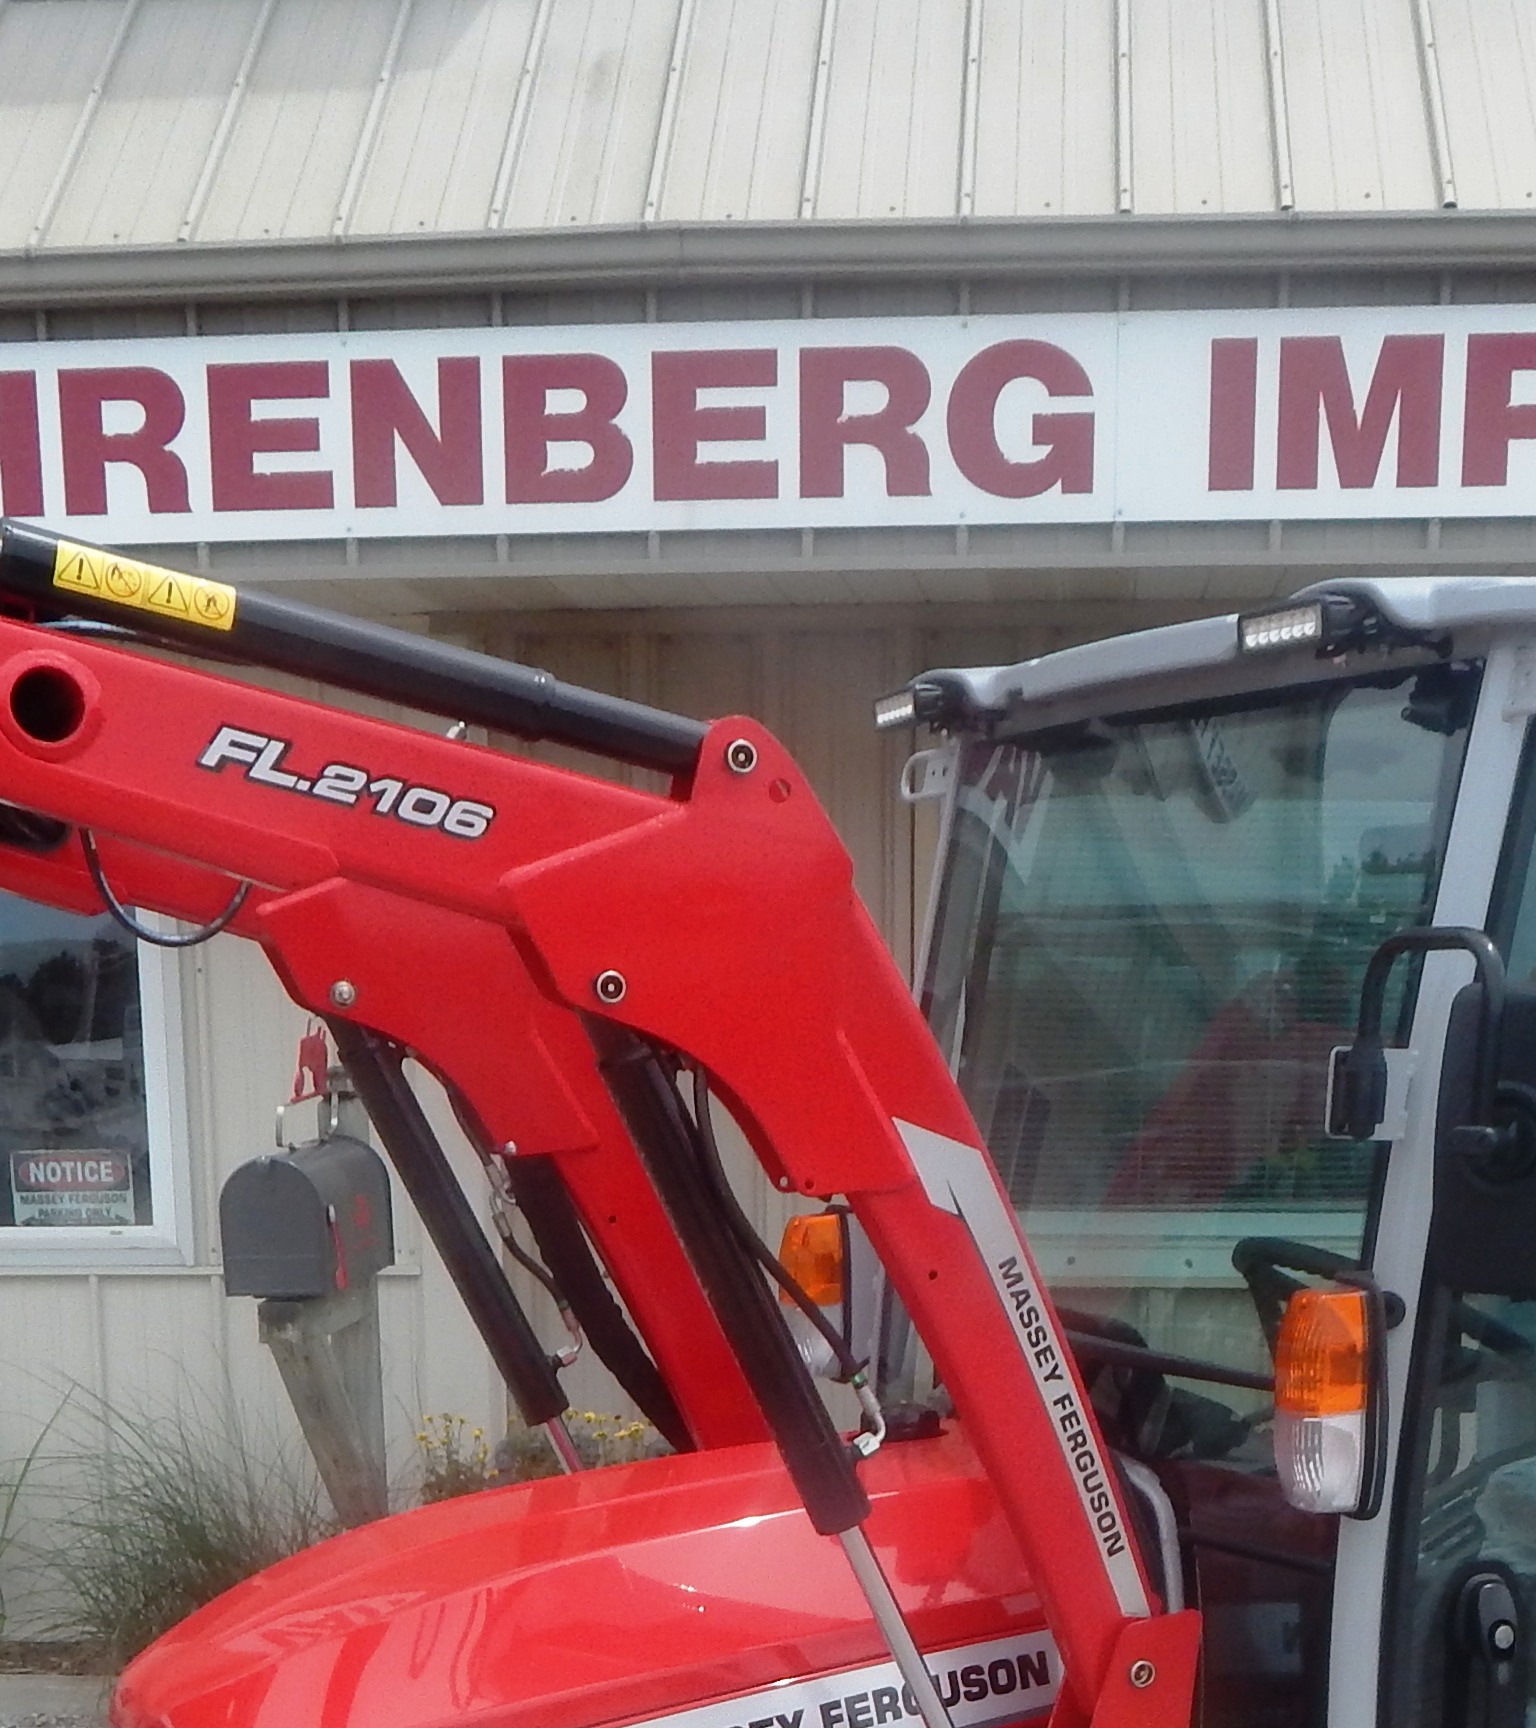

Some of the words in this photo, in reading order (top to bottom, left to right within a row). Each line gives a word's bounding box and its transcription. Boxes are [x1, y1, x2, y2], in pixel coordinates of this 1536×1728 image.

[197, 723, 497, 839] FL.2106
[19, 1193, 64, 1205] MASSEY
[29, 1161, 114, 1183] NOTICE
[998, 1256, 1063, 1385] MASSEY
[1052, 1392, 1126, 1558] FERGUSON
